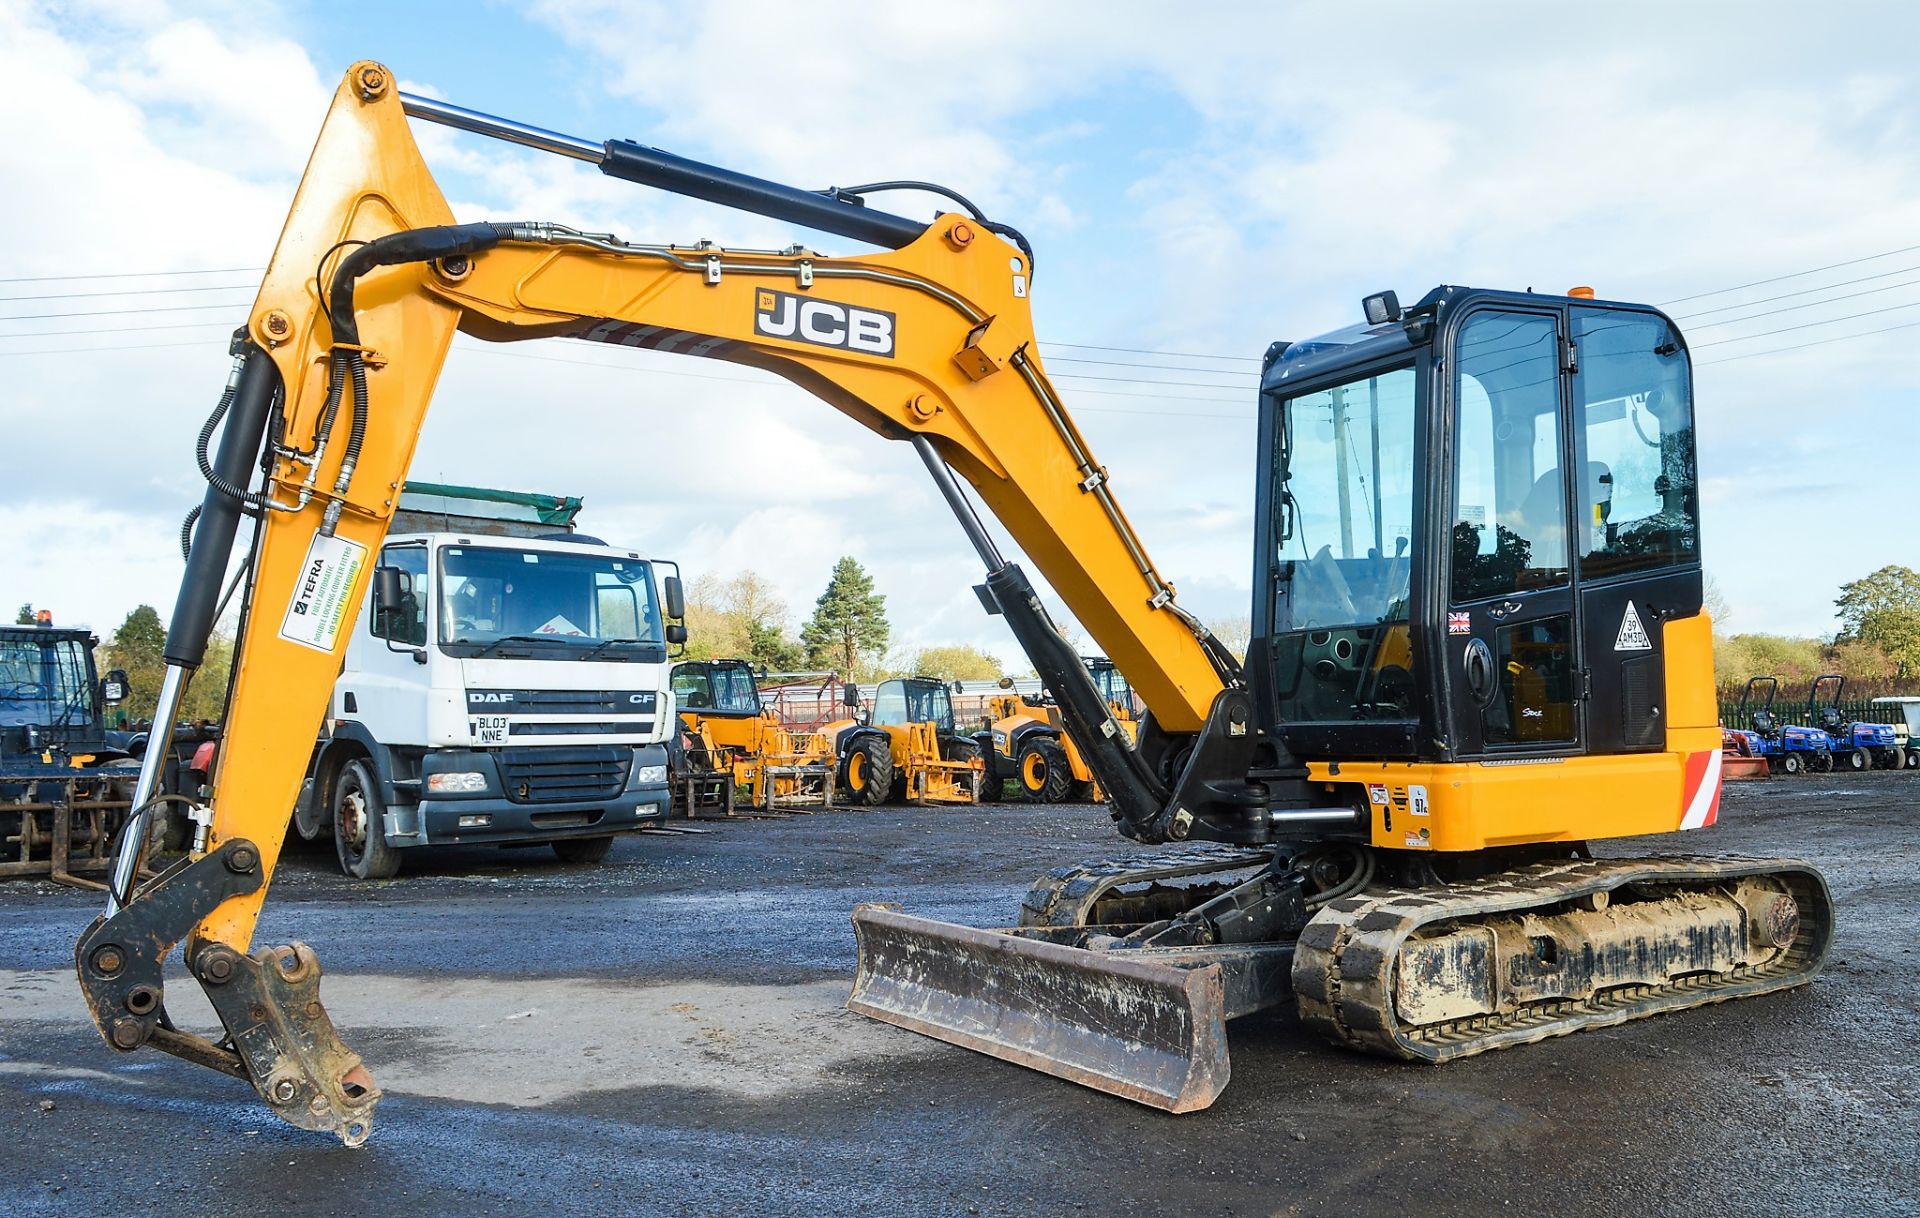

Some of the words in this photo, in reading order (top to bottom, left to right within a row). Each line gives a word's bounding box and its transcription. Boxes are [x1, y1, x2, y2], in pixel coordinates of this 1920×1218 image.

[758, 296, 893, 354] JCB
[302, 560, 324, 600] TEFRA
[344, 560, 358, 590] REQUIRED
[311, 598, 322, 616] FULLY
[319, 564, 334, 598] AUTOMATIC
[314, 618, 327, 642] DOUBLE
[323, 593, 336, 618] LOCKING
[332, 567, 345, 593] COUPLER
[342, 546, 352, 564] FITTED
[339, 591, 347, 602] PIN
[331, 603, 343, 624] SAFETY
[328, 625, 336, 635] NO
[1627, 620, 1637, 632] 39
[469, 694, 514, 703] DAF
[629, 694, 655, 704] CF
[479, 718, 506, 729] BL03
[481, 730, 502, 741] NNE
